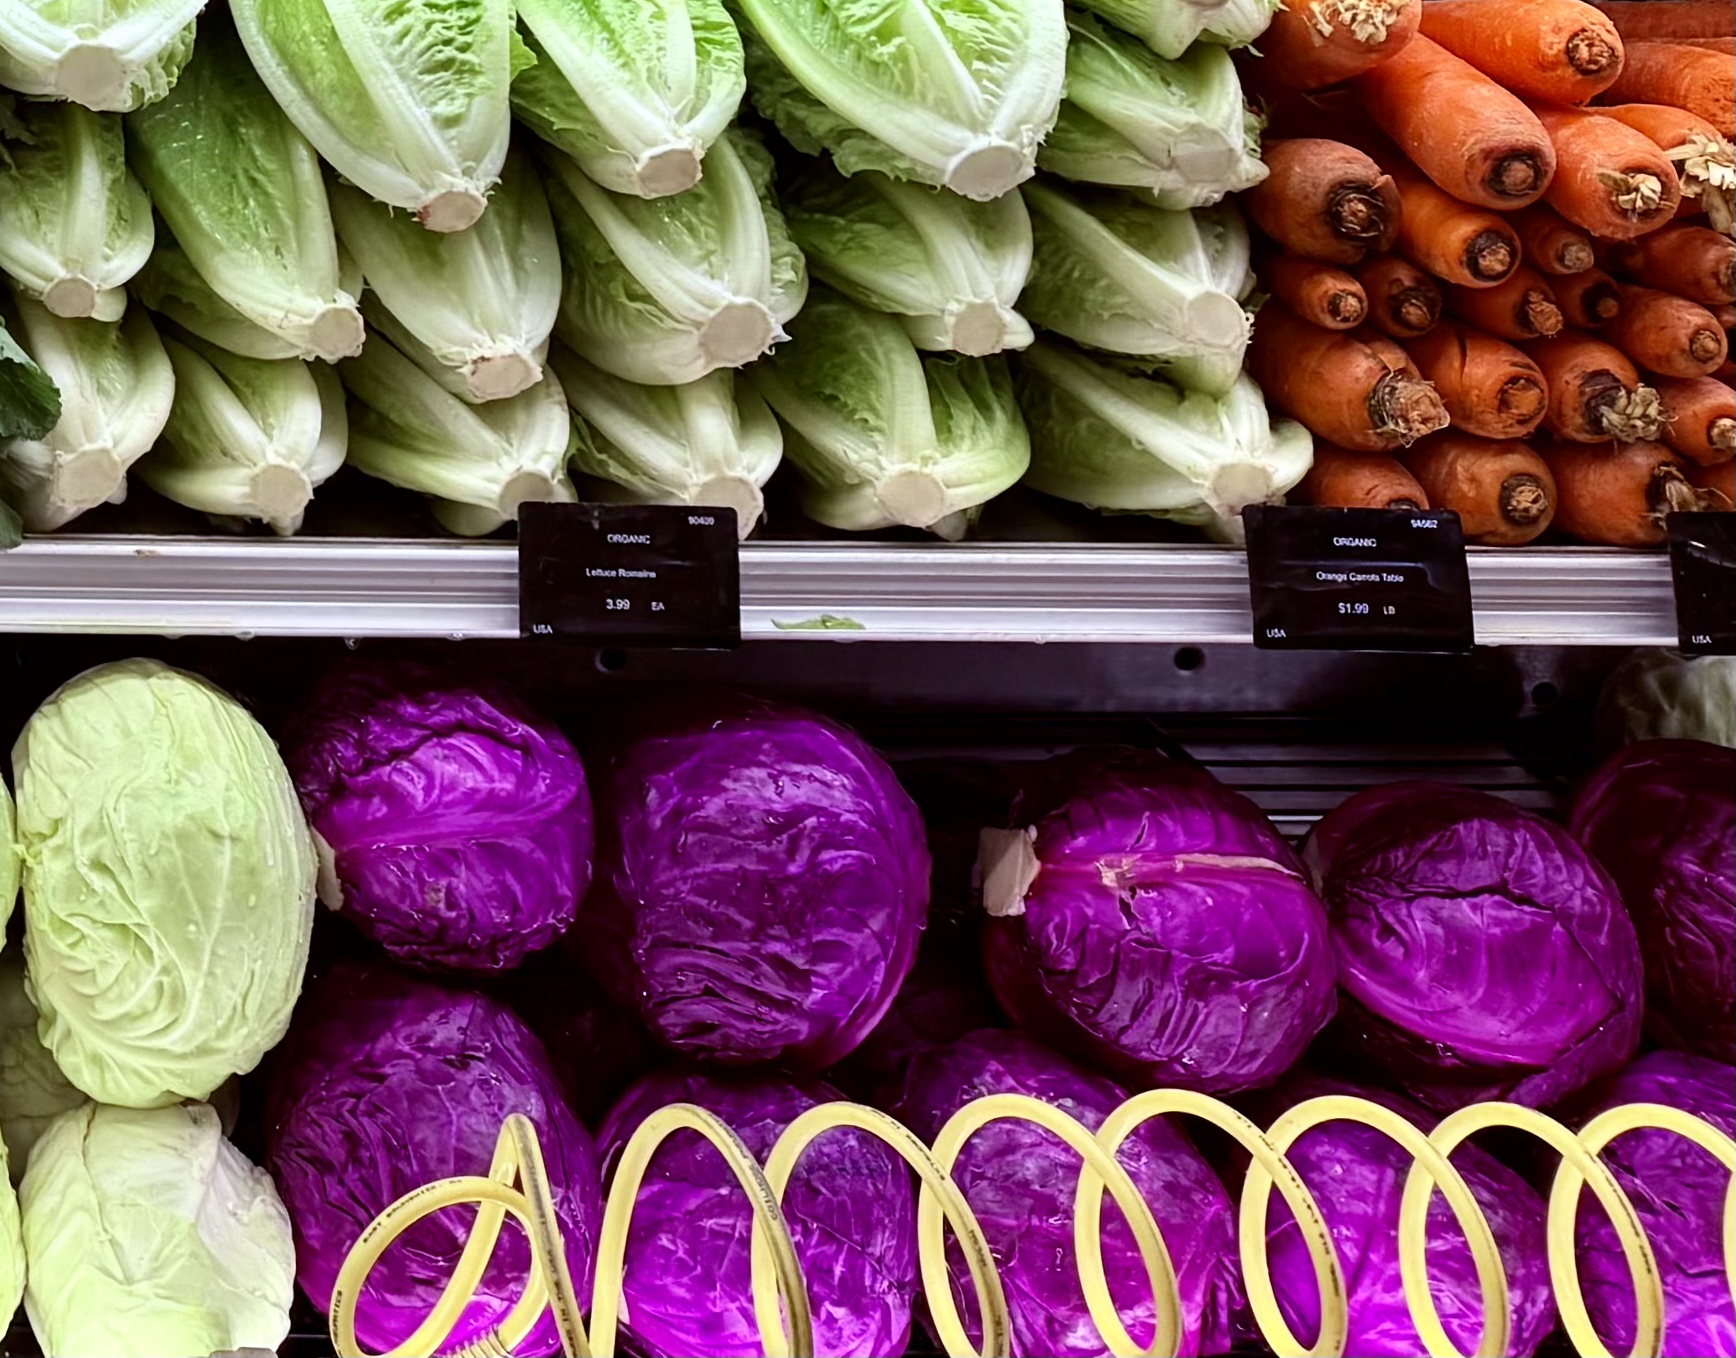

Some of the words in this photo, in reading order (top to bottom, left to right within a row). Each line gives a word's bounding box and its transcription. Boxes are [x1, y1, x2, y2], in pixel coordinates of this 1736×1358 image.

[607, 534, 650, 544] ORGANIC
[1333, 537, 1376, 547] ORGANIC
[586, 568, 616, 577] Lettuce
[618, 569, 656, 578] Romaine
[1349, 572, 1379, 582] Carrots
[1382, 573, 1404, 582] Table
[606, 599, 630, 609] 3.99
[651, 602, 665, 611] EA
[1338, 603, 1369, 614] $1.99
[533, 624, 552, 633] USA
[1267, 628, 1286, 638] USA
[1692, 635, 1712, 644] USA
